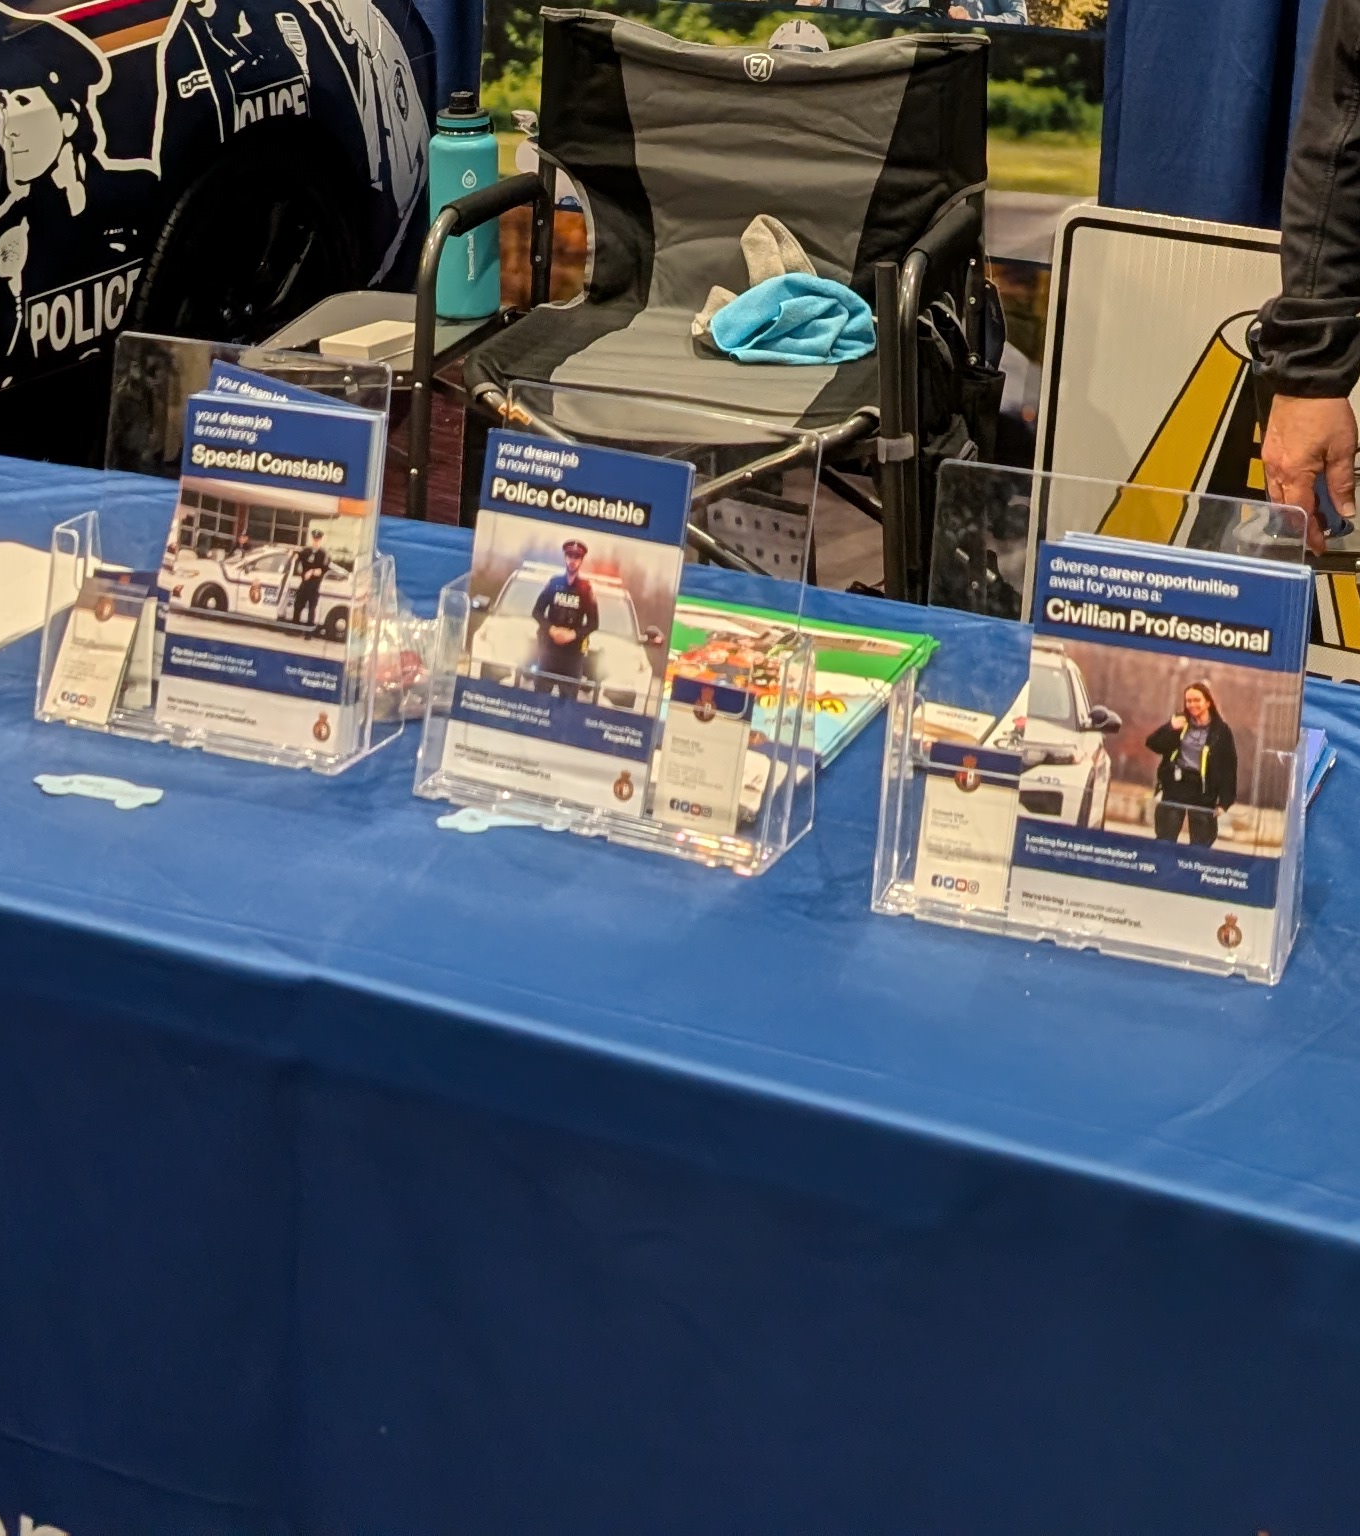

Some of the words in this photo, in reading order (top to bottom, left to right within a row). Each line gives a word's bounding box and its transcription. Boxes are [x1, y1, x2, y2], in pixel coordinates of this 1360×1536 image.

[216, 375, 240, 392] your
[240, 382, 271, 401] dream
[195, 410, 218, 424] your
[219, 411, 253, 428] dream
[253, 416, 273, 432] job
[202, 425, 226, 439] now
[191, 443, 256, 471] Special
[256, 452, 345, 484] Constable
[495, 457, 507, 469] is
[506, 459, 530, 472] now
[498, 442, 523, 457] your
[524, 445, 559, 462] dream
[559, 450, 580, 468] job
[491, 476, 549, 508] Police
[550, 488, 645, 526] Constable
[1049, 575, 1084, 591] await
[1086, 578, 1105, 594] for
[1106, 584, 1131, 599] you
[1132, 588, 1149, 600] as
[1050, 557, 1099, 577] diverse
[1100, 564, 1145, 583] career
[1146, 572, 1239, 598] opportunities
[554, 591, 580, 609] POLICE
[1046, 598, 1126, 631] Civilian
[1129, 610, 1270, 652] Professional
[1201, 873, 1228, 886] People
